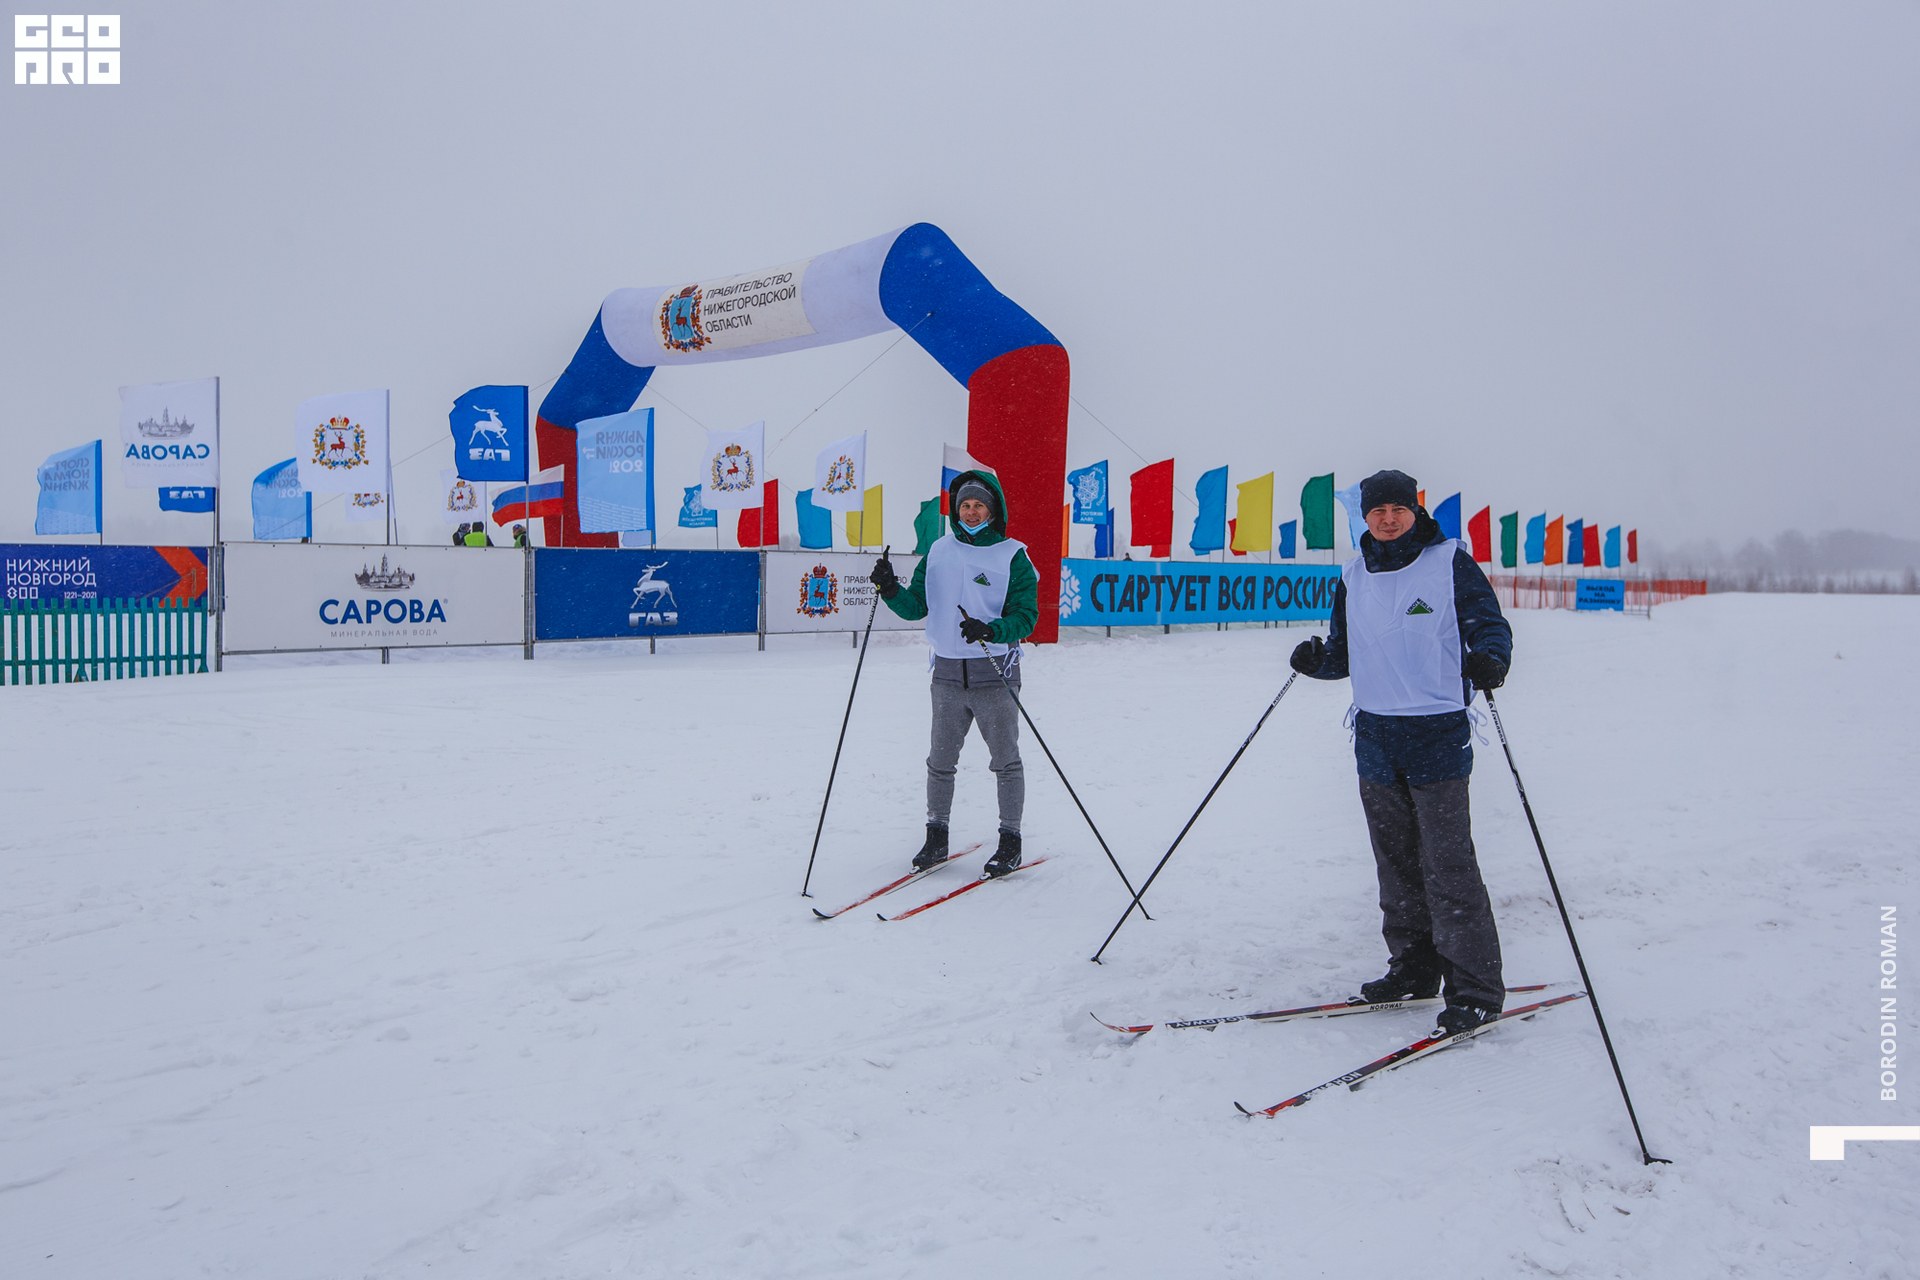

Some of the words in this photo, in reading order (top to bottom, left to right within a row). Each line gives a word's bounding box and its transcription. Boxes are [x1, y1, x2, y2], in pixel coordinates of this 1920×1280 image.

[705, 271, 792, 299] ПРАВИТЕЛЬСТВО
[703, 284, 796, 316] НИЖЕГОРОДСКОЙ
[705, 313, 752, 333] ОБЛАСТИ
[6, 556, 90, 572] НИЖНИЙ
[6, 572, 97, 588] НОВГОРОД
[1090, 573, 1211, 613] СТАРТУЕТ
[1217, 575, 1256, 611] ВСЯ
[1262, 575, 1339, 610] РОССИЯ
[843, 598, 876, 606] ОБЛАСТ
[319, 598, 447, 625] САРОВА
[628, 611, 679, 627] ГАЗ
[330, 629, 408, 638] МИНЕРАЛЬНАЯ
[412, 628, 438, 636] ВОДА
[1369, 1002, 1404, 1011] NORDWAY
